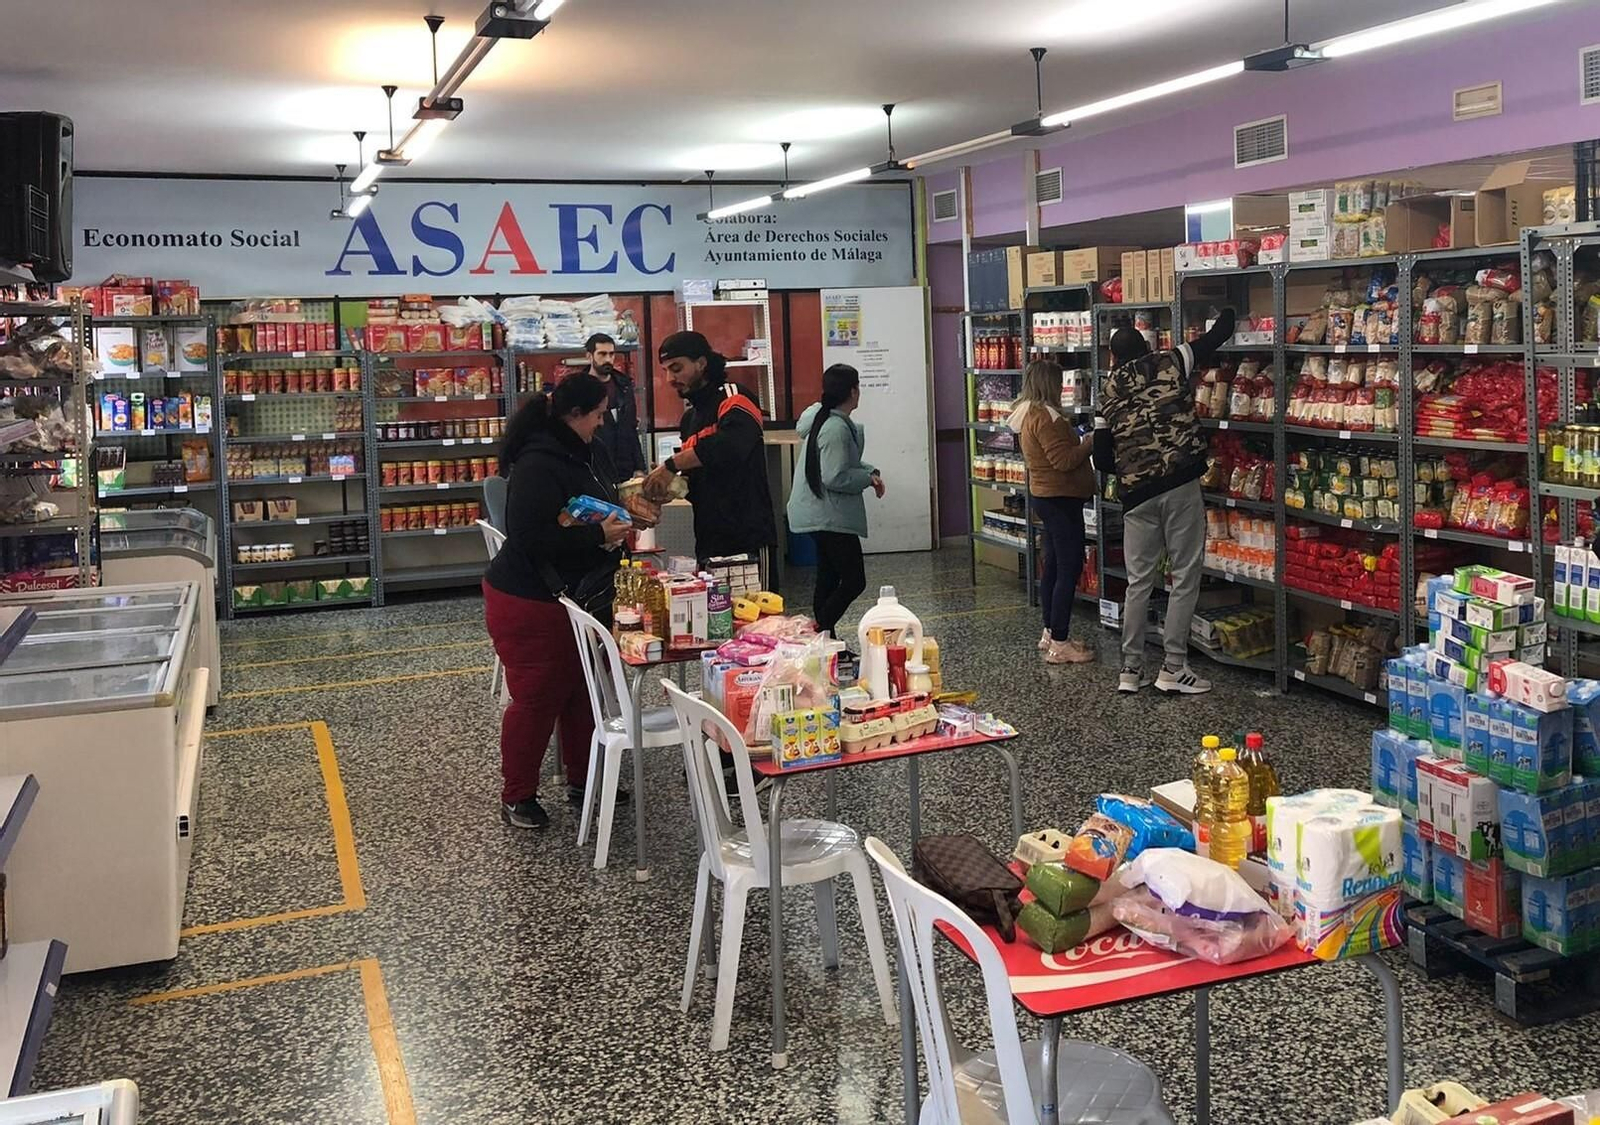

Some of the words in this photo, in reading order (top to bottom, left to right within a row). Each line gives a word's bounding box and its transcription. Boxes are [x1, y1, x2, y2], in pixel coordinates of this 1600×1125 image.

[83, 228, 222, 248] Economato
[230, 228, 300, 248] Social
[325, 201, 675, 276] ASAEC
[704, 227, 739, 243] Área
[744, 229, 761, 243] de
[765, 229, 830, 243] Derechos
[834, 229, 889, 243] Sociales
[704, 248, 806, 265] Ayuntamiento
[810, 248, 827, 261] de
[831, 247, 883, 263] Málaga
[16, 579, 60, 593] Dulcesol
[710, 593, 725, 604] Sin
